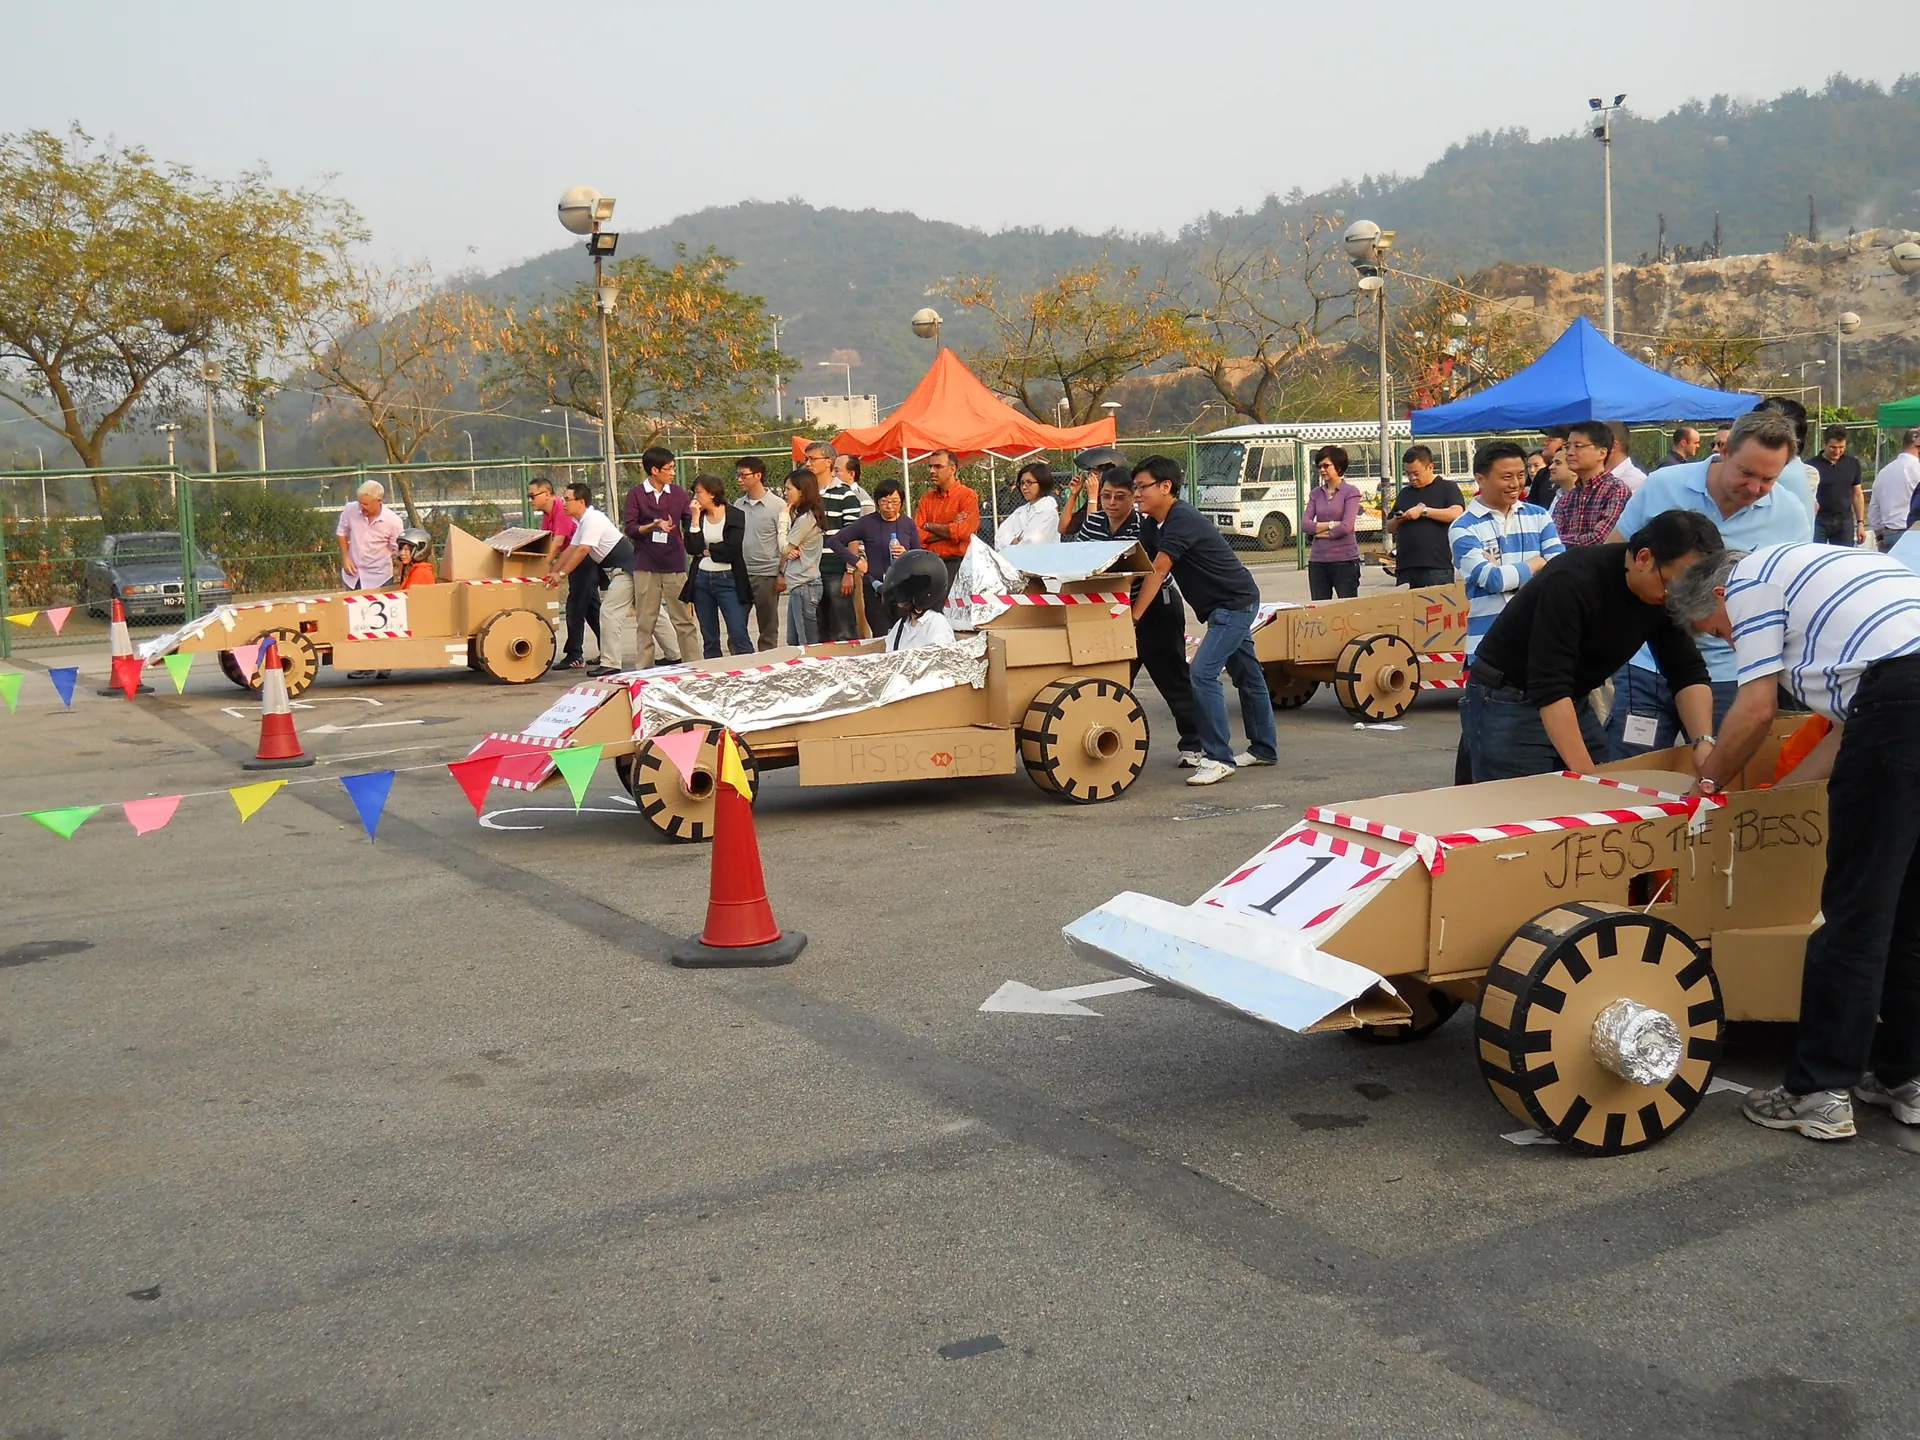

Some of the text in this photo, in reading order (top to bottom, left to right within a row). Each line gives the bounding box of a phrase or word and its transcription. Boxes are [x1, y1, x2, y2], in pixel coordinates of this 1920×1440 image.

[369, 601, 388, 630] 3
[850, 743, 932, 774] HSBC
[1544, 809, 1823, 889] JESS THE BESS
[1247, 856, 1337, 916] 1
